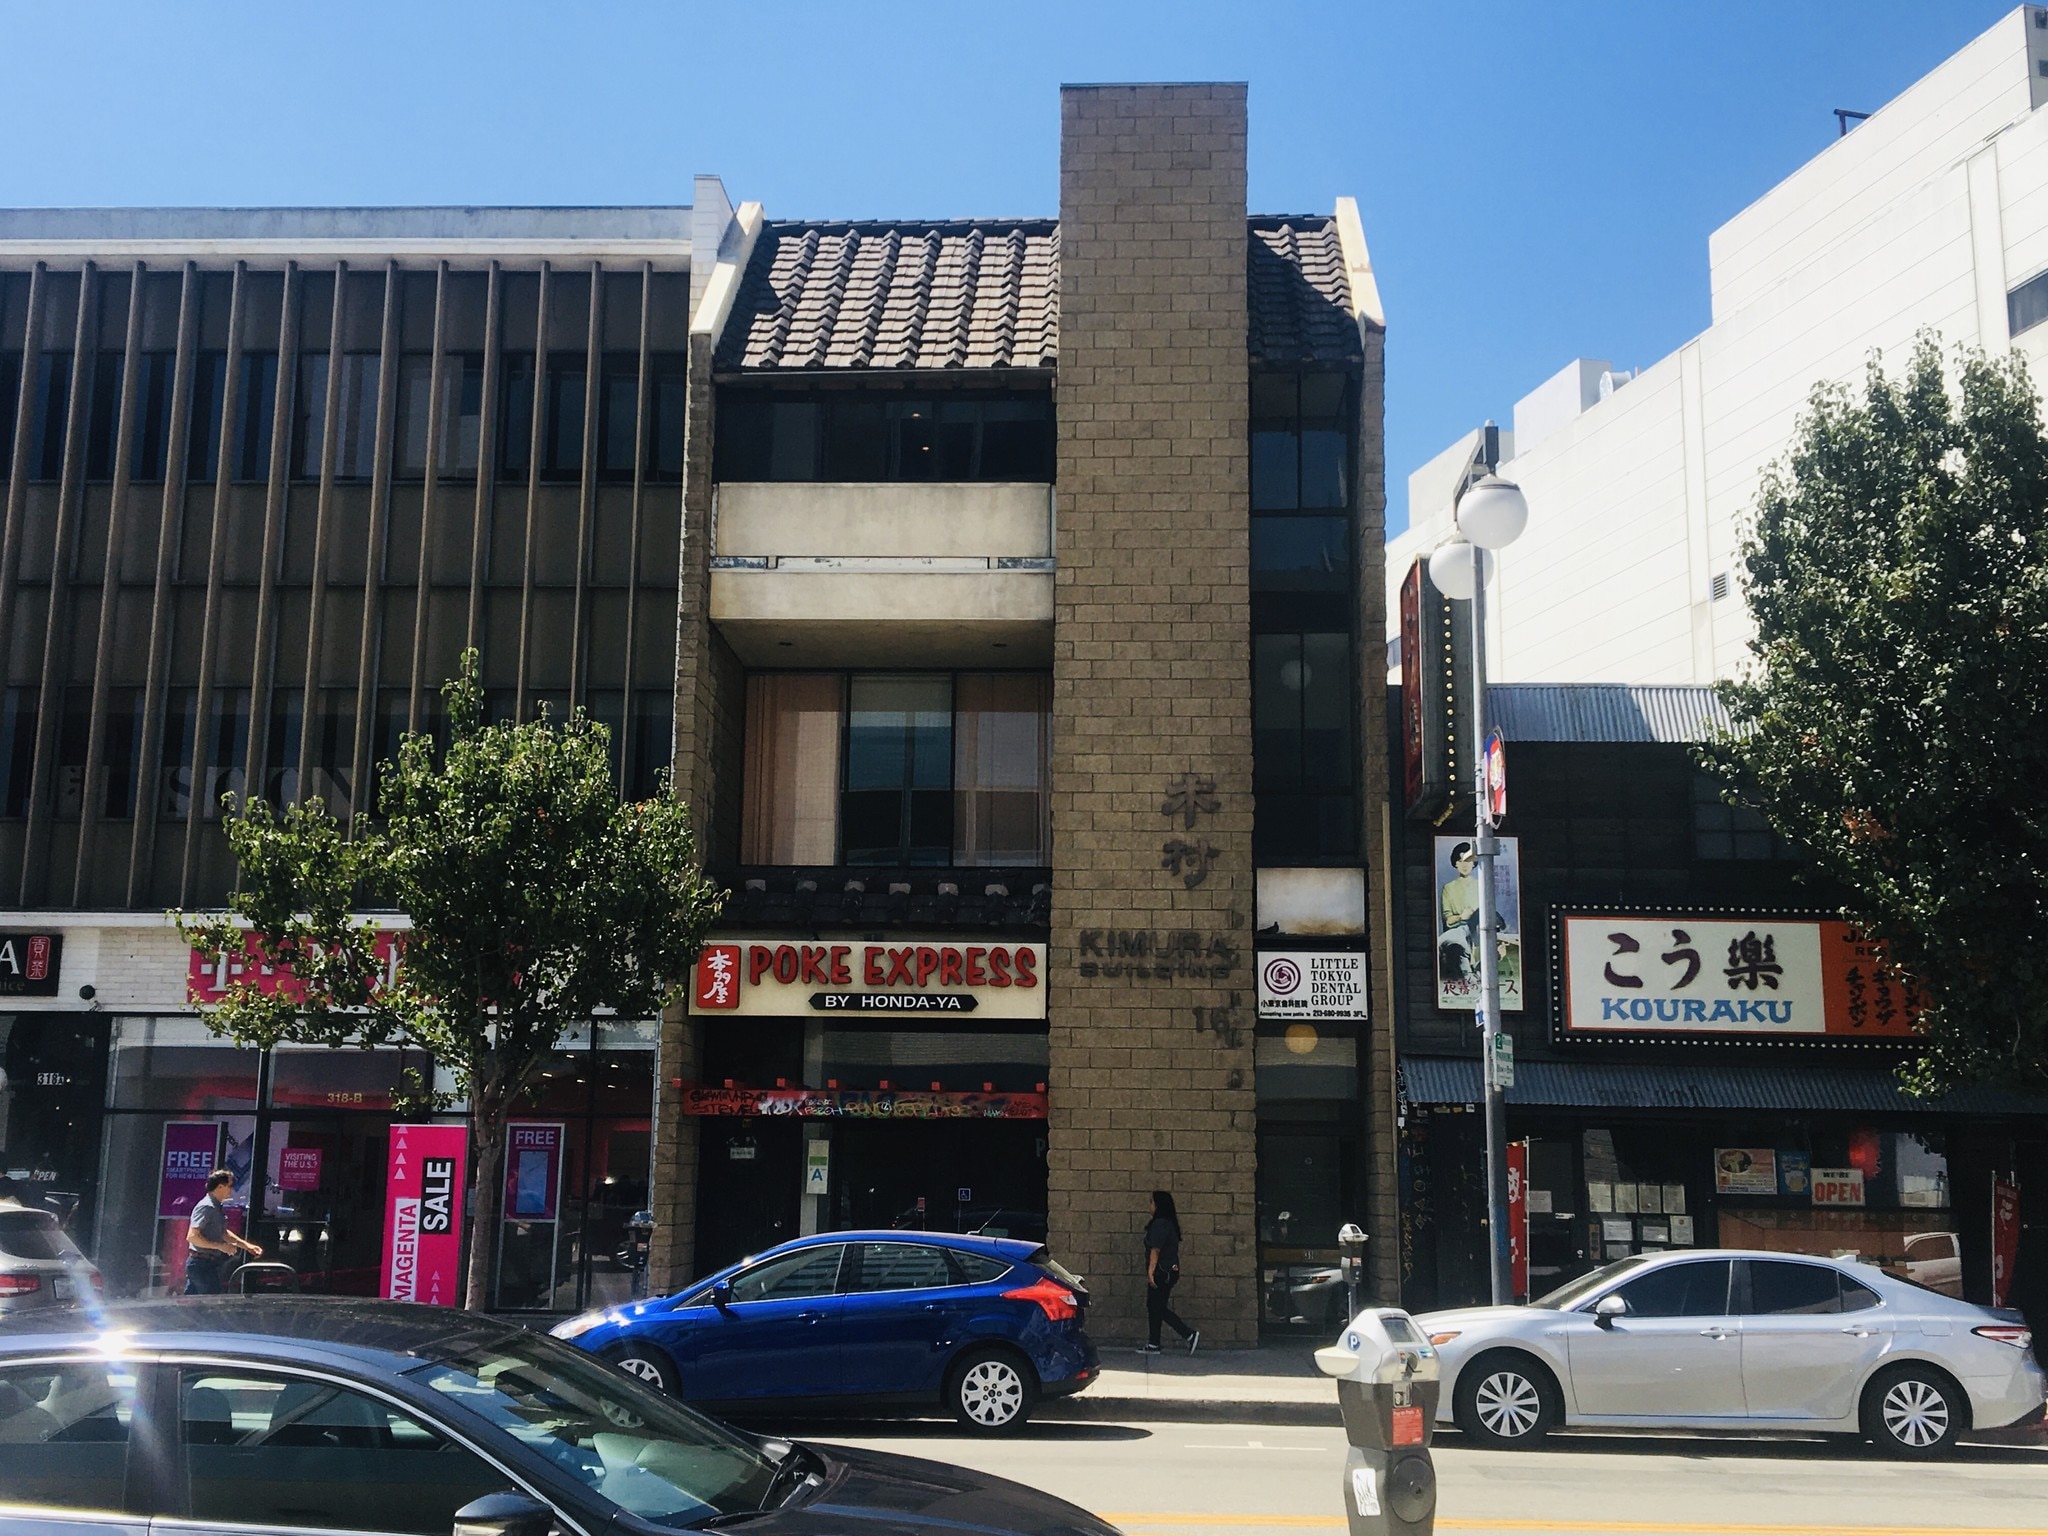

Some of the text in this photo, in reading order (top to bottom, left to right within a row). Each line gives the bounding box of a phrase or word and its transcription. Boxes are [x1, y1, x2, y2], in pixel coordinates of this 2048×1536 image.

[1080, 930, 1231, 957] KIMURA
[749, 945, 1037, 987] POKE EXPRESS
[1311, 958, 1359, 969] LITTLE
[1311, 971, 1351, 981] TOKYO
[1311, 983, 1361, 993] DENTAL
[825, 995, 961, 1009] BY HONDA-YA
[1311, 995, 1354, 1006] GROUP
[1602, 998, 1793, 1024] KOURAKU
[327, 1093, 362, 1103] 318-B
[516, 1131, 554, 1144] FREE
[167, 1151, 212, 1167] FREE
[285, 1153, 316, 1161] VISITING
[284, 1160, 298, 1168] THE
[811, 1168, 823, 1181] A
[423, 1162, 451, 1231] SALE
[1815, 1183, 1861, 1202] OPEN
[394, 1204, 417, 1301] MAGENTA
